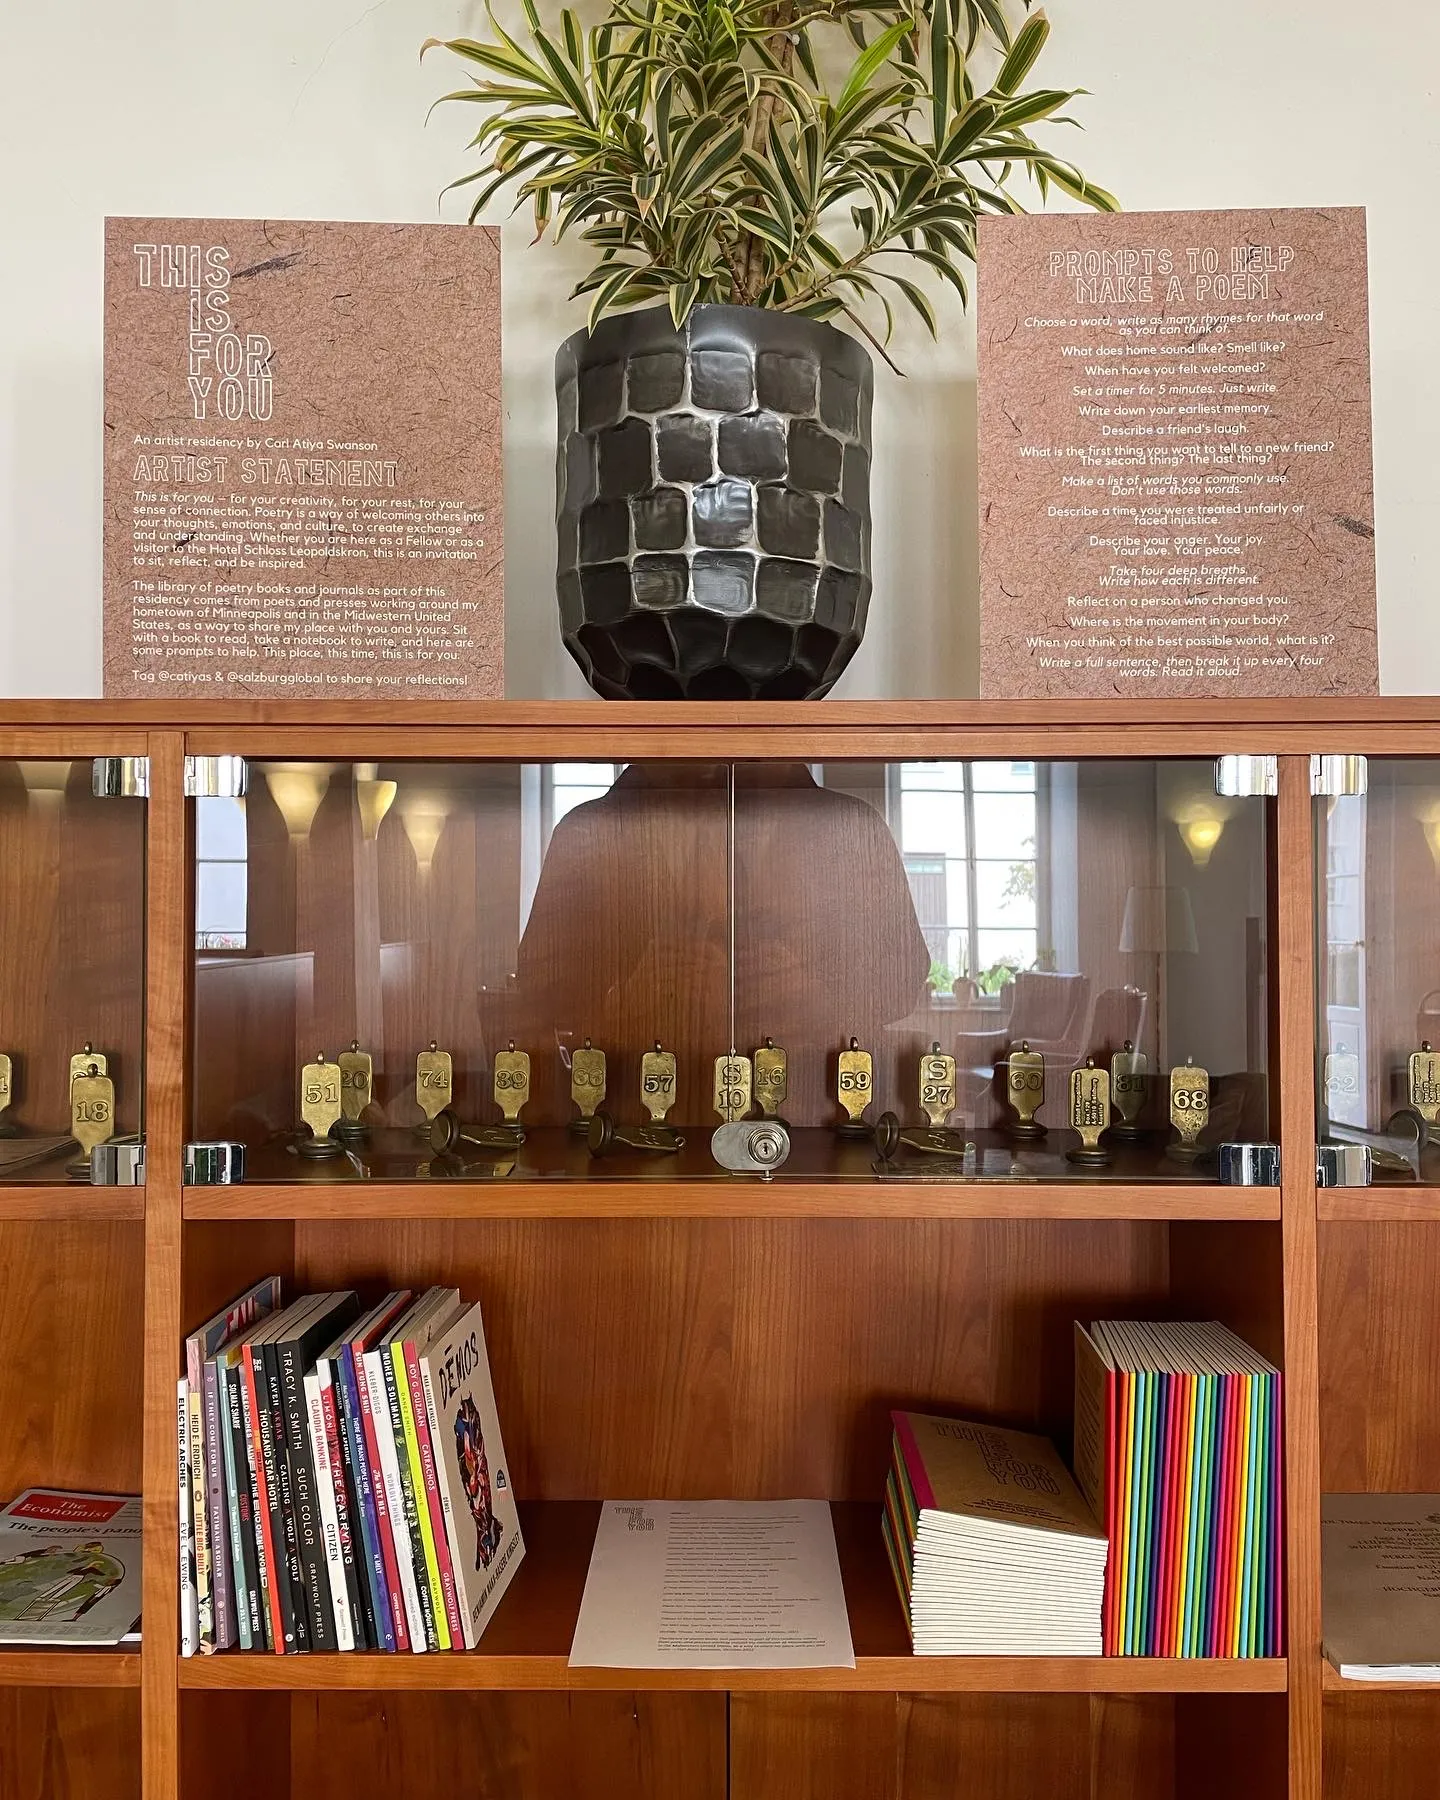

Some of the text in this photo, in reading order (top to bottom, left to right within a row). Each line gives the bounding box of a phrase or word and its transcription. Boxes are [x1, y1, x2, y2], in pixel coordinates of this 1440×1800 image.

[133, 244, 230, 289] THIS
[1049, 245, 1295, 277] PROMPTS TO HELP
[1076, 273, 1269, 303] MAKE A POEM
[190, 289, 230, 333] IS
[1024, 311, 1324, 328] Choose a word, write as many rhymes for that word
[1118, 323, 1231, 337] as you can think of.
[189, 334, 273, 378] FOR
[1061, 341, 1286, 357] What does home sound like? Smell like?
[1084, 362, 1266, 377] When have you felt welcomed?
[187, 376, 274, 421] YOU
[133, 435, 378, 451] An artist residency by Carl Atiya Swanson
[133, 455, 397, 487] ARTIST STATEMENT
[134, 491, 157, 502] This
[160, 491, 169, 502] is
[172, 491, 191, 503] for
[193, 494, 215, 505] you
[230, 493, 247, 504] for
[250, 496, 276, 507] your
[279, 495, 337, 508] creativity,
[341, 496, 358, 507] for
[361, 498, 387, 509] your
[390, 498, 415, 509] rest,
[419, 497, 436, 508] for
[439, 500, 464, 511] your
[132, 670, 468, 686] Tag @catiyas & @salzburgglobal to share your reflections!
[341, 1070, 369, 1089] 20
[419, 1069, 448, 1088] 74
[496, 1070, 527, 1089] 39
[723, 1064, 741, 1084] S
[757, 1067, 785, 1086] 16
[840, 1072, 871, 1091] 59
[928, 1061, 947, 1080] S
[1010, 1071, 1041, 1091] 60
[305, 1082, 338, 1104] 51
[644, 1074, 674, 1092] 57
[924, 1086, 951, 1104] 27
[718, 1089, 746, 1109] 10
[1173, 1089, 1208, 1110] 68
[76, 1101, 109, 1122] 18
[355, 1351, 370, 1414] SUN YUNG SHIN
[408, 1363, 417, 1381] ROY
[228, 1383, 238, 1406] SOLMAZ
[282, 1350, 303, 1450] TRACY K. SMITH
[382, 1352, 401, 1428] MOHEB SOLIMAN
[231, 1406, 241, 1430] SHARIF
[269, 1376, 284, 1441] KAVEH AKBAR
[400, 1392, 412, 1436] DANEZ SMITH
[191, 1414, 199, 1434] HEID
[259, 1409, 272, 1458] THOUSAND
[310, 1399, 328, 1471] CLAUDIA RANKINE
[178, 1397, 187, 1488] ELECTRIC ARCHES
[193, 1444, 201, 1480] ERDRICH
[265, 1459, 276, 1485] STAR
[421, 1444, 436, 1491] CATRACHOS
[279, 1464, 291, 1505] CALLING
[374, 1482, 383, 1500] WET
[19, 1503, 110, 1518] Economist
[59, 1500, 87, 1509] The
[269, 1487, 279, 1511] HOTEL
[297, 1467, 314, 1546] SUCH COLOR
[331, 1460, 352, 1564] THE CARRYING
[8, 1521, 38, 1531] The
[38, 1525, 102, 1534] people's
[180, 1522, 188, 1542] EVE
[286, 1517, 295, 1544] WOLF
[195, 1513, 205, 1576] LITTLE BIG BULLY
[326, 1523, 339, 1561] CITIZEN
[181, 1556, 189, 1590] EWING
[290, 1555, 299, 1582] WOLF
[309, 1562, 324, 1640] GRAYWOLF PRESS
[442, 1572, 458, 1632] GRAYWOLF PRESS
